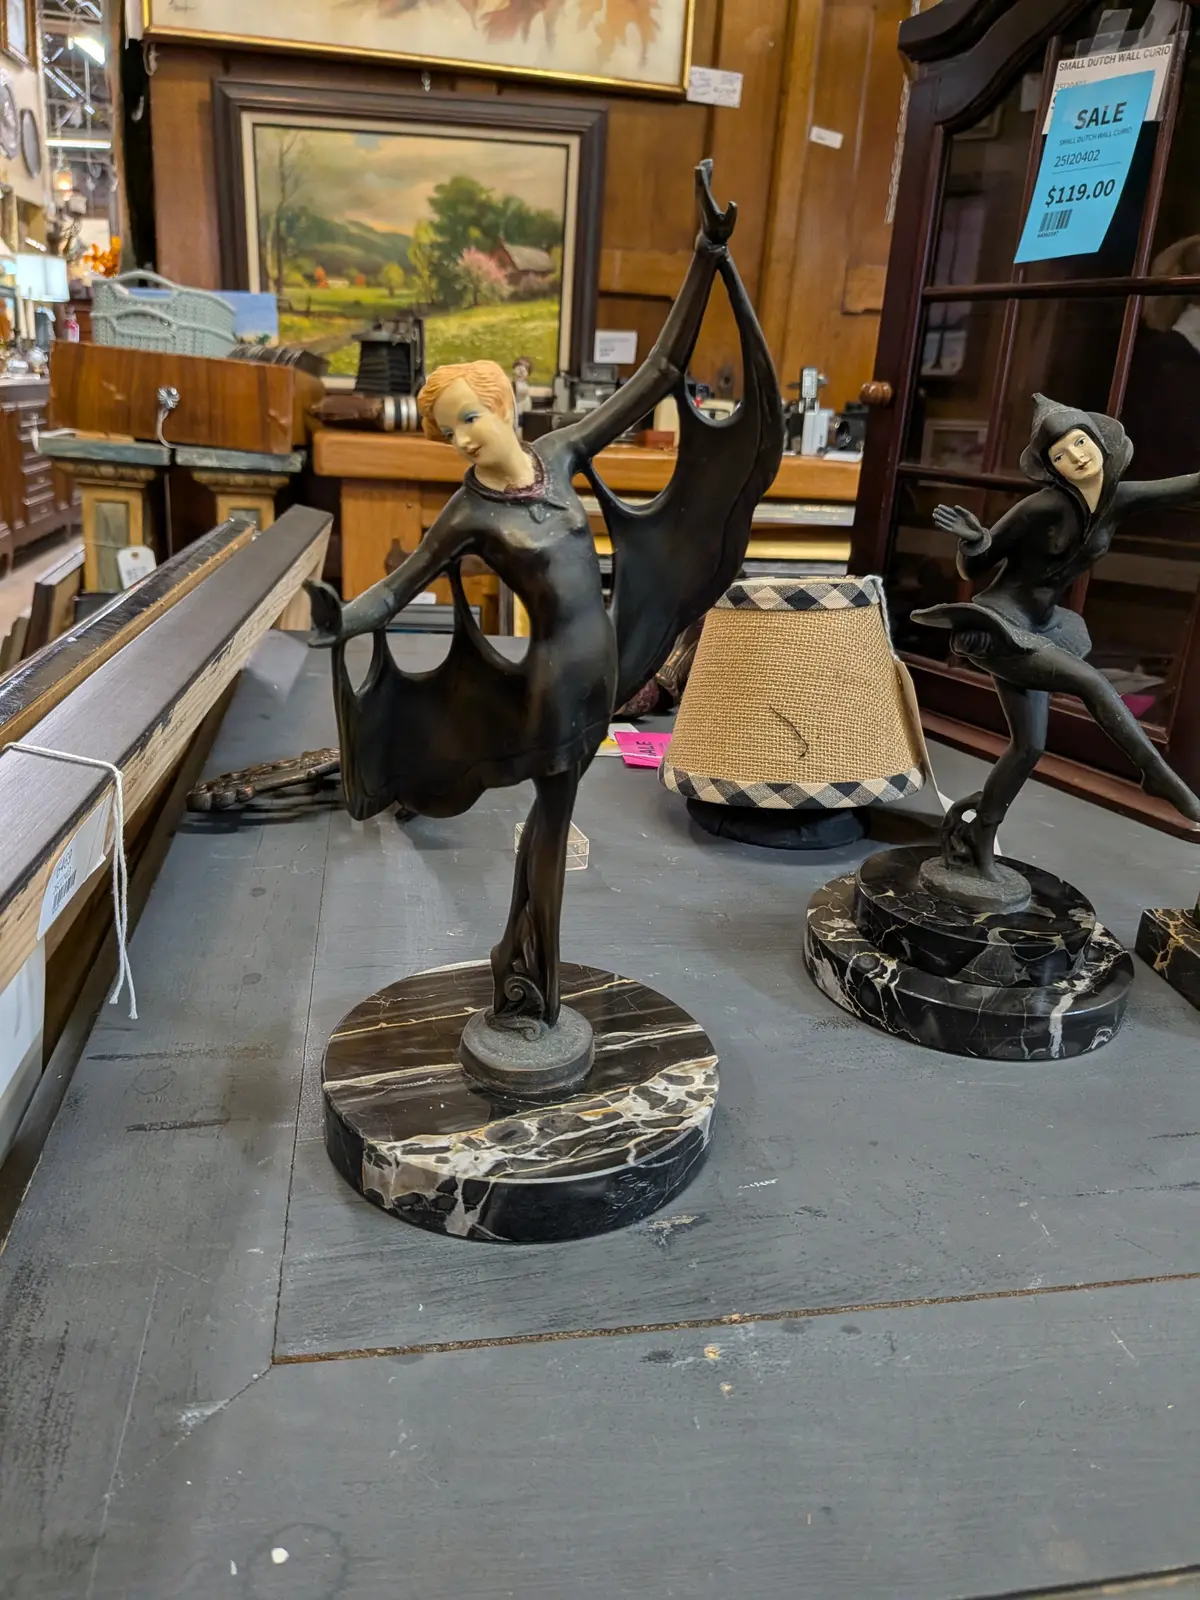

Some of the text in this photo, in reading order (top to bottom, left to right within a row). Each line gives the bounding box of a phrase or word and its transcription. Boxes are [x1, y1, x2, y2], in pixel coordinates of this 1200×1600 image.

[1059, 46, 1171, 72] SMALL DUTCH WALL CURIO
[1074, 102, 1128, 130] SALE
[1059, 126, 1133, 146] SMALL DUTCH WALL CURIO
[1045, 178, 1116, 208] $119.00
